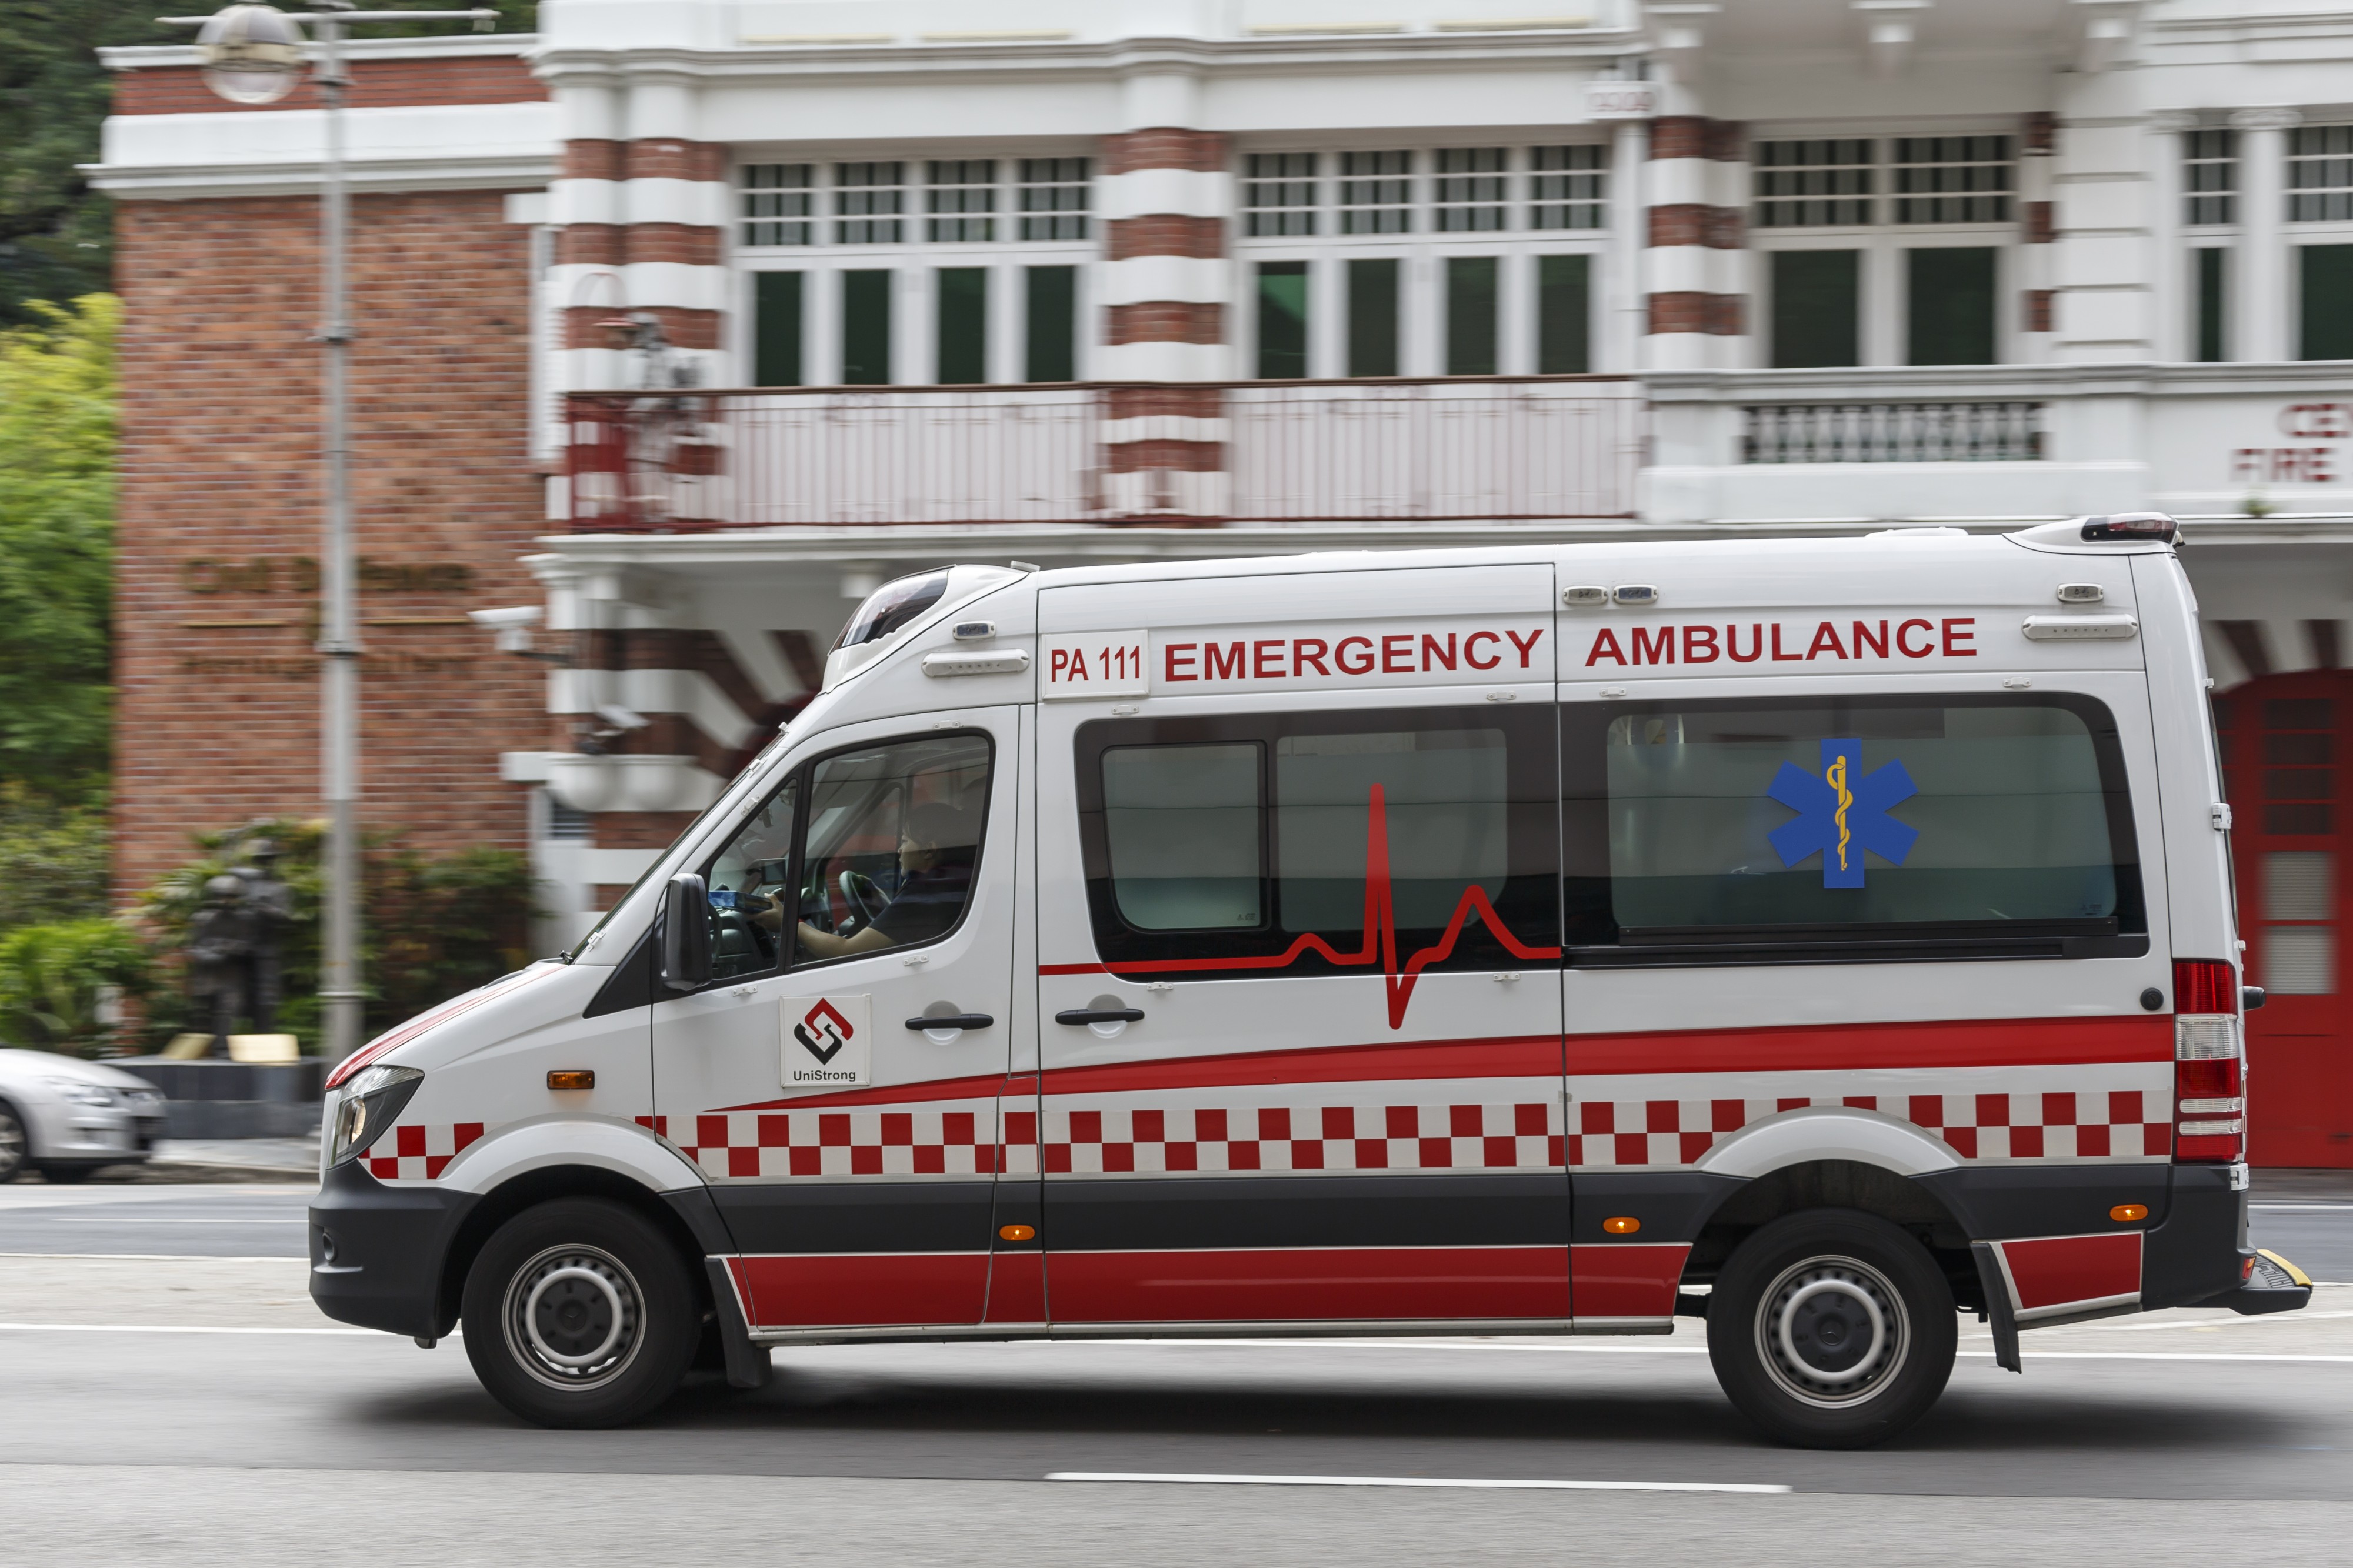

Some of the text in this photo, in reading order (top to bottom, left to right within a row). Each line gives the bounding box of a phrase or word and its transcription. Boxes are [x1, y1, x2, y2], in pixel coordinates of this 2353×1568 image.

[2275, 403, 2353, 438] CE
[2231, 447, 2337, 482] FIRE
[1051, 645, 1140, 683] PA 111
[1165, 617, 1978, 682] EMERGENCY AMBULANCE
[793, 1070, 856, 1082] UniStrong
